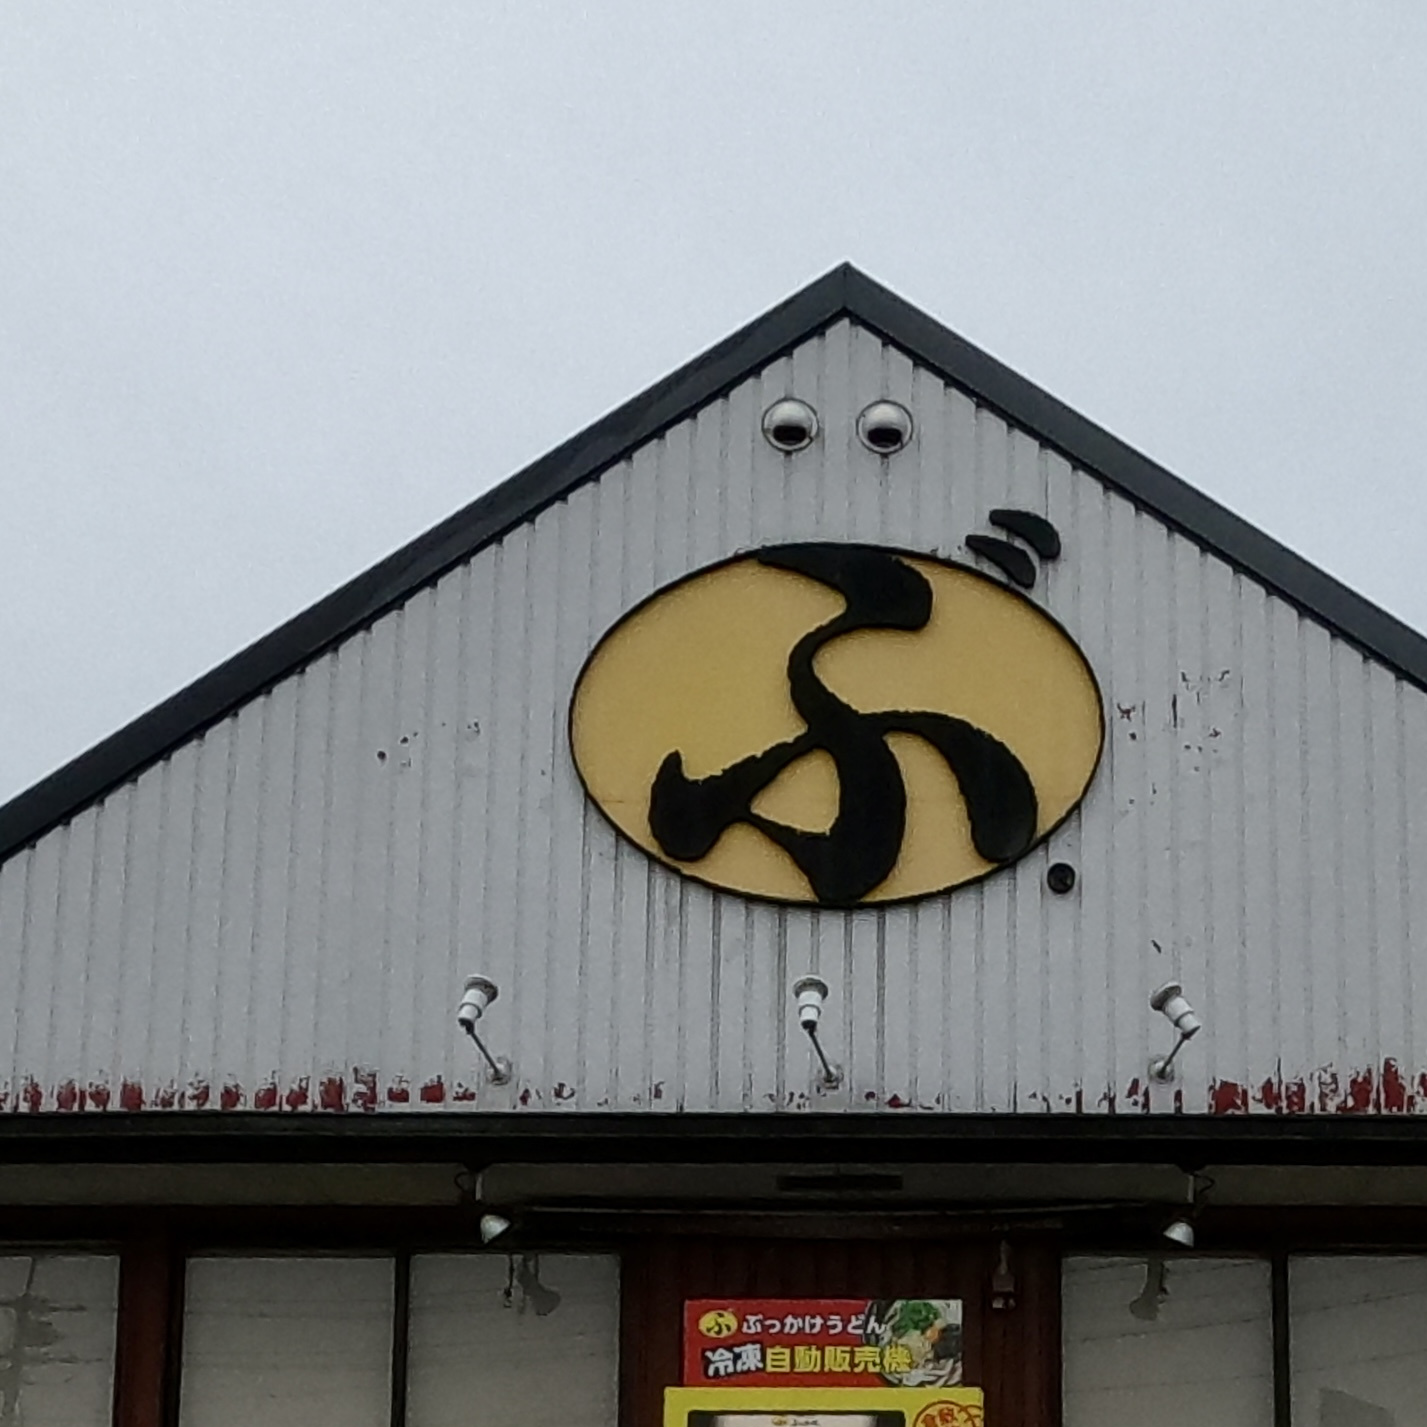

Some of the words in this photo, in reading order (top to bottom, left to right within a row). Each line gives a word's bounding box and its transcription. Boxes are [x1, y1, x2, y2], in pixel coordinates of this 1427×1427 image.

[741, 1313, 887, 1335] ぶっかけうどん
[705, 1342, 913, 1378] 冷凍自動販売機
